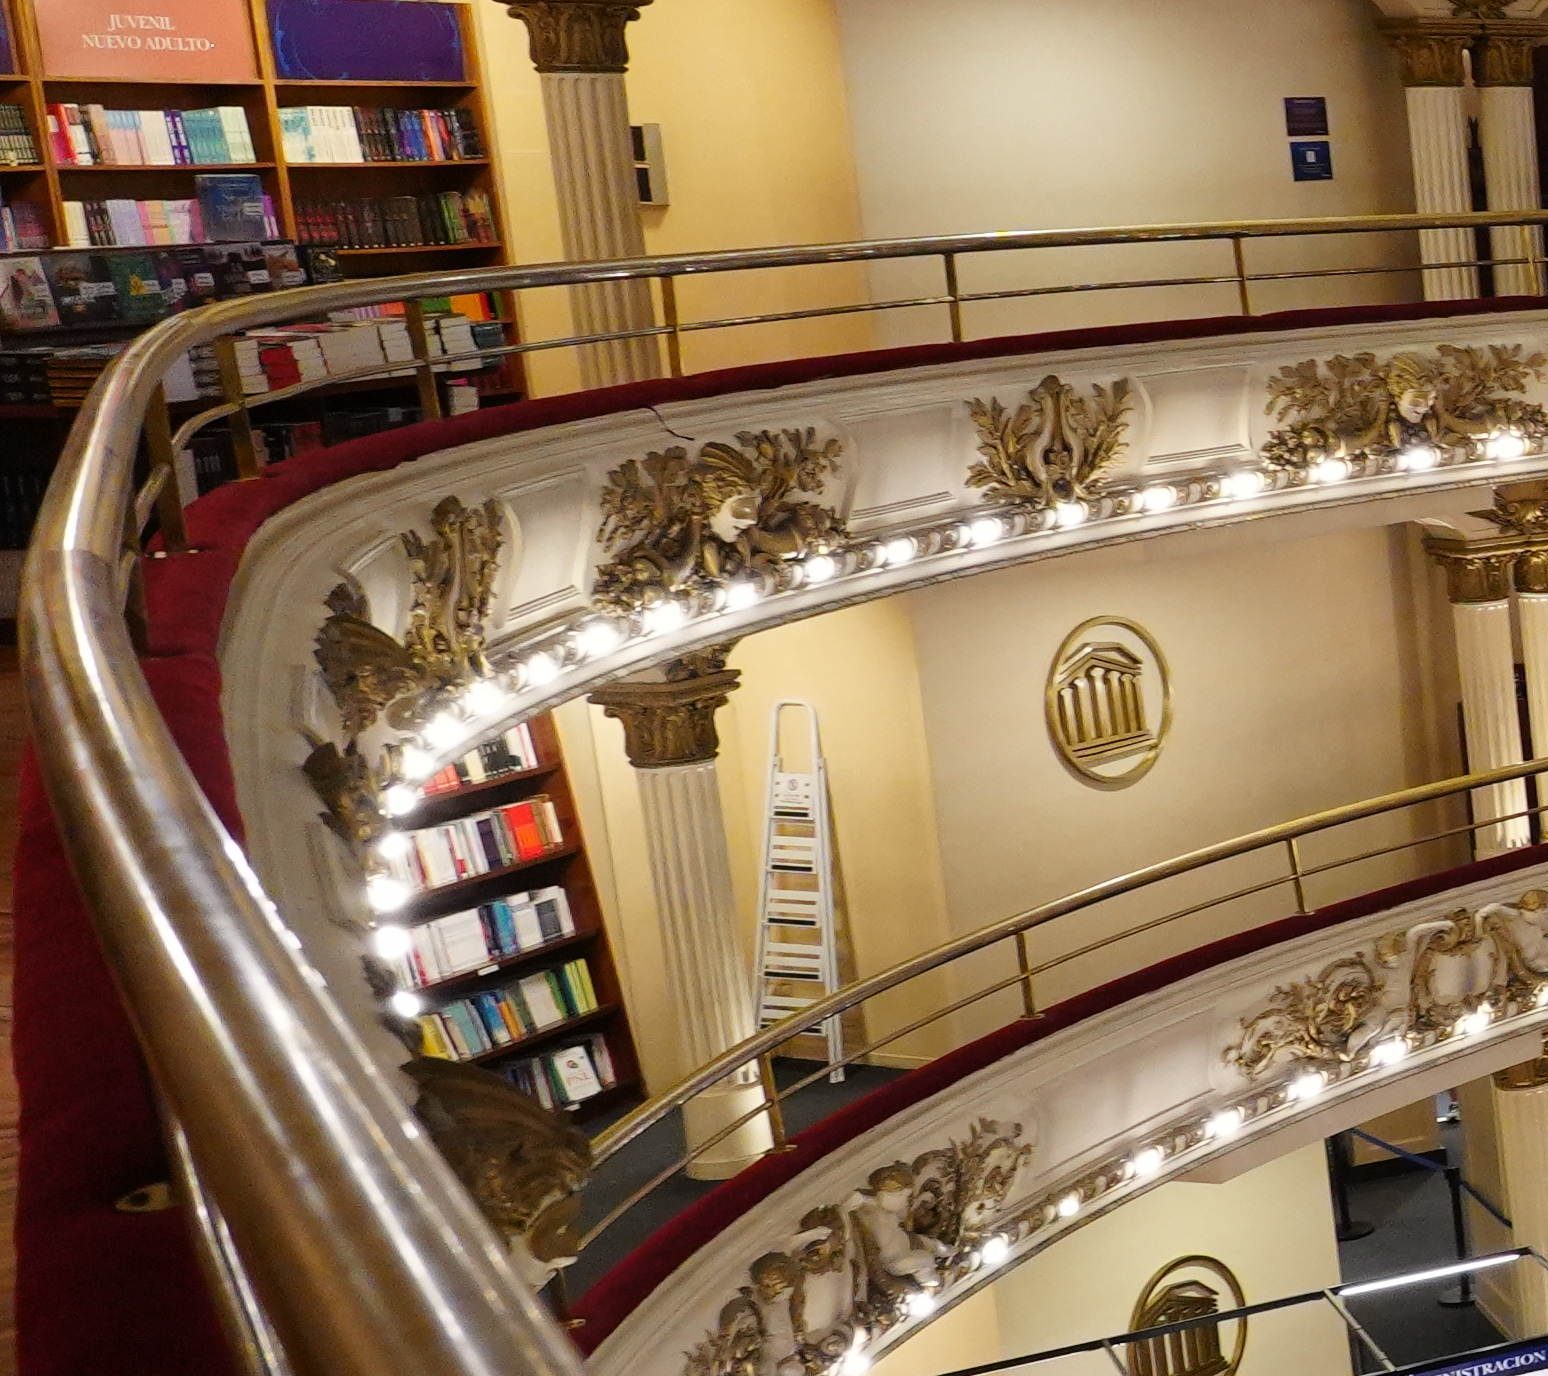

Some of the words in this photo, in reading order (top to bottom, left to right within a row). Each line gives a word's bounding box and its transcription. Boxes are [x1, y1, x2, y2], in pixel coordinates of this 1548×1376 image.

[108, 14, 176, 31] JUVENIL
[82, 34, 142, 49] NUEVO
[144, 36, 211, 51] ADULTO
